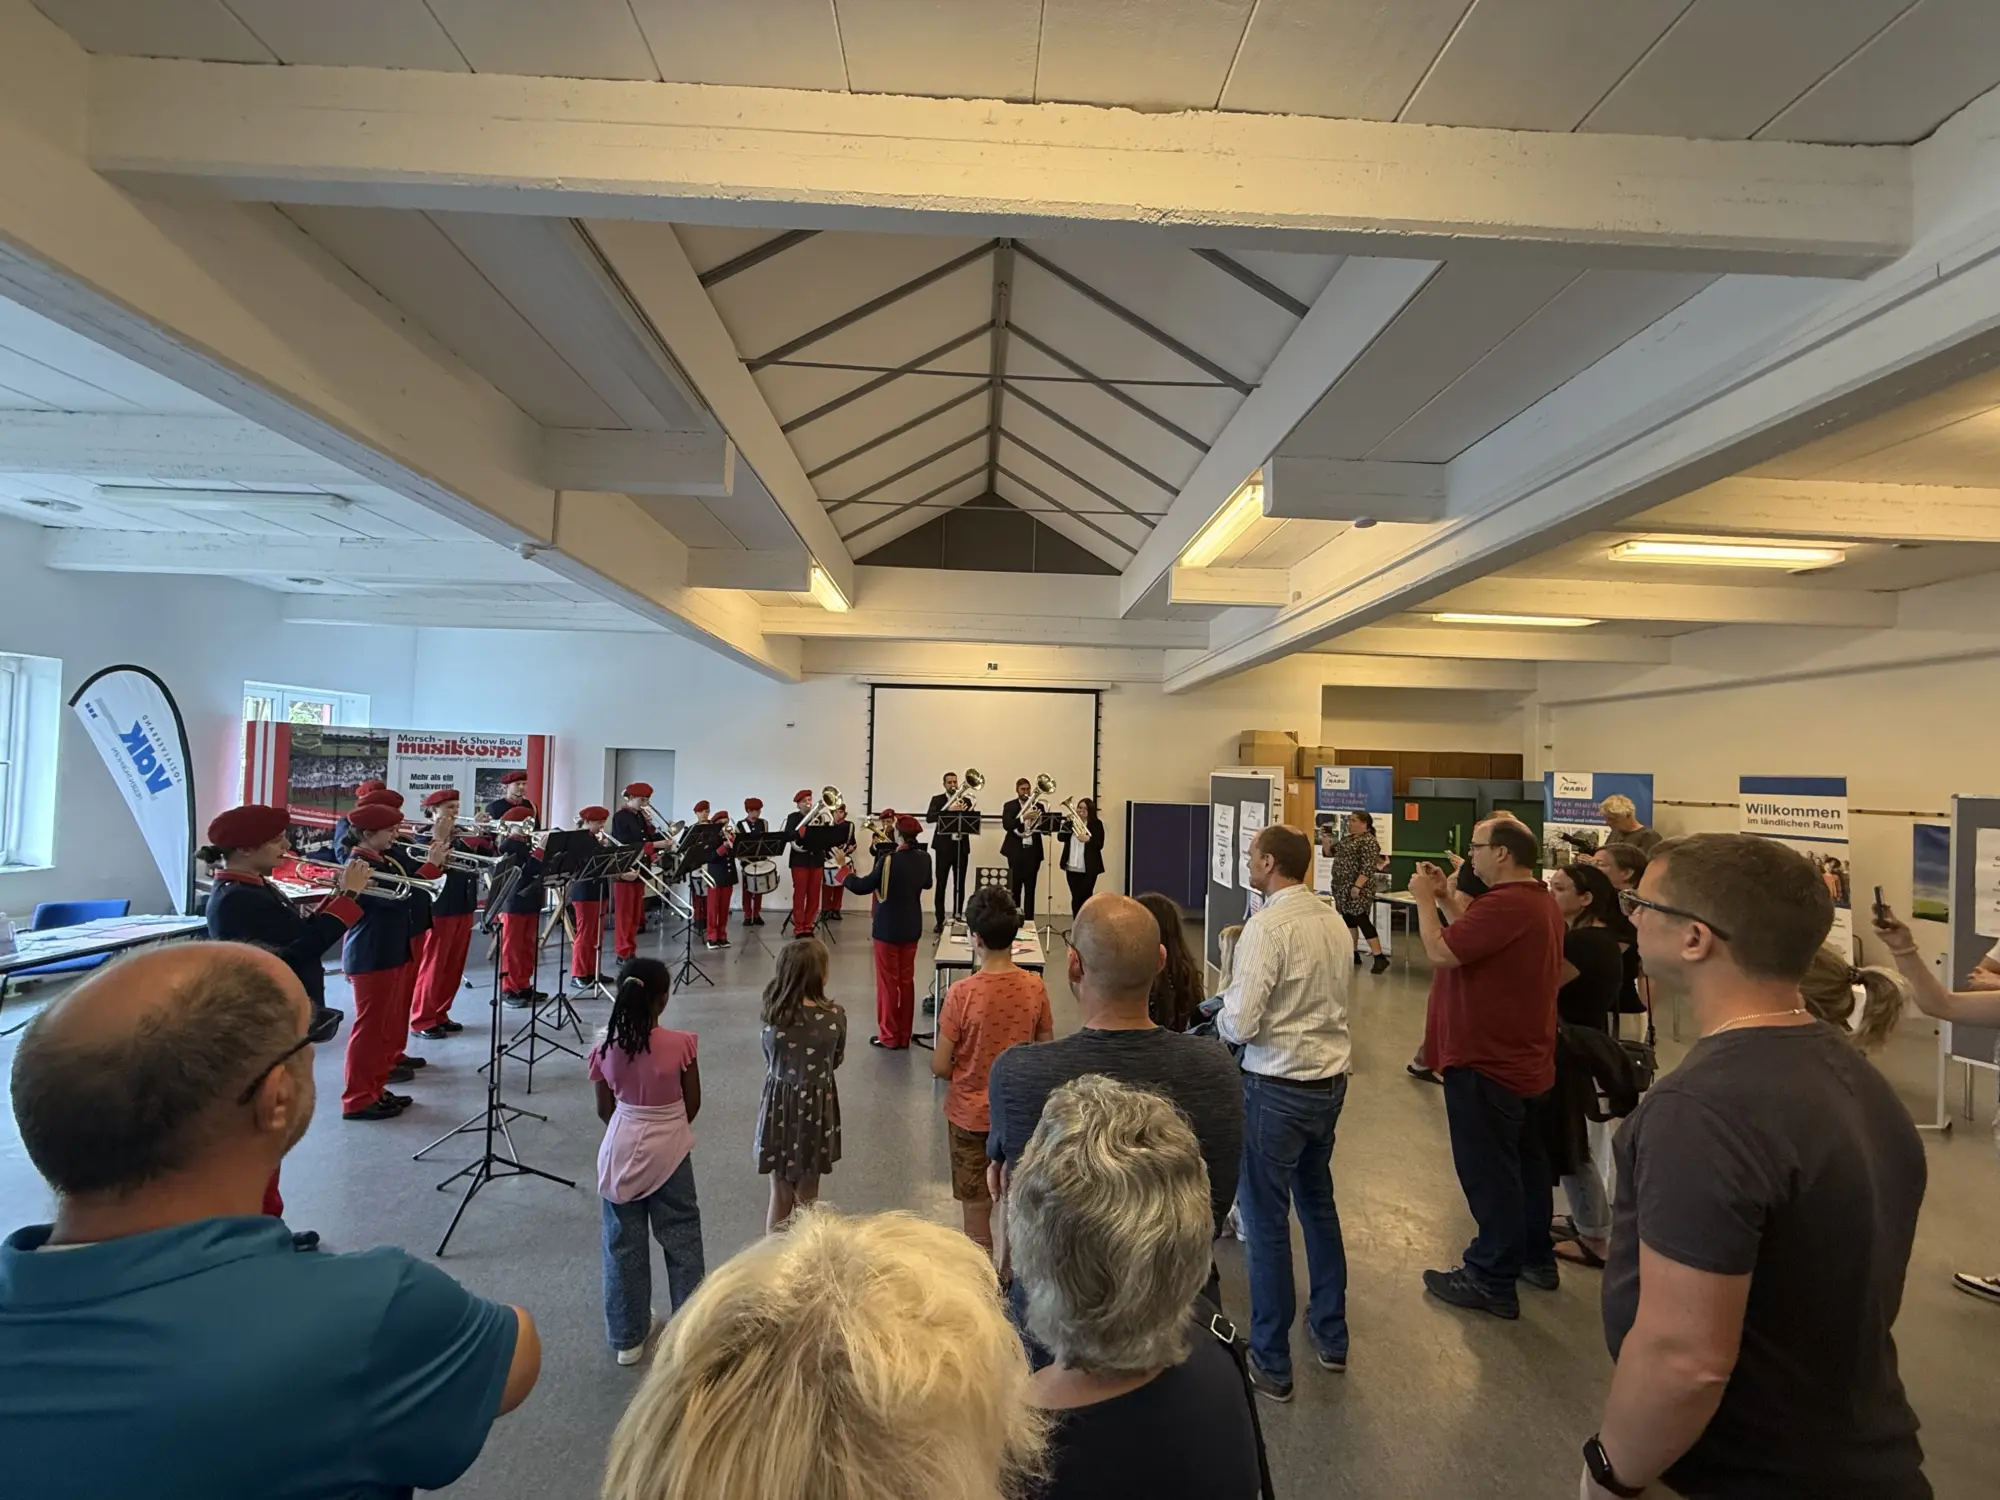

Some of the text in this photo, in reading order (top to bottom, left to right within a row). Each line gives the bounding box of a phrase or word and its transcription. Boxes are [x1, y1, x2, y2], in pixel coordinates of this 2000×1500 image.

[470, 737, 498, 745] Show
[499, 738, 522, 746] Band
[397, 740, 522, 759] musikcorps
[410, 773, 429, 781] Mehr
[1745, 803, 1840, 819] Willkommen
[1760, 818, 1810, 828] ländlichen
[1813, 821, 1844, 831] Raum
